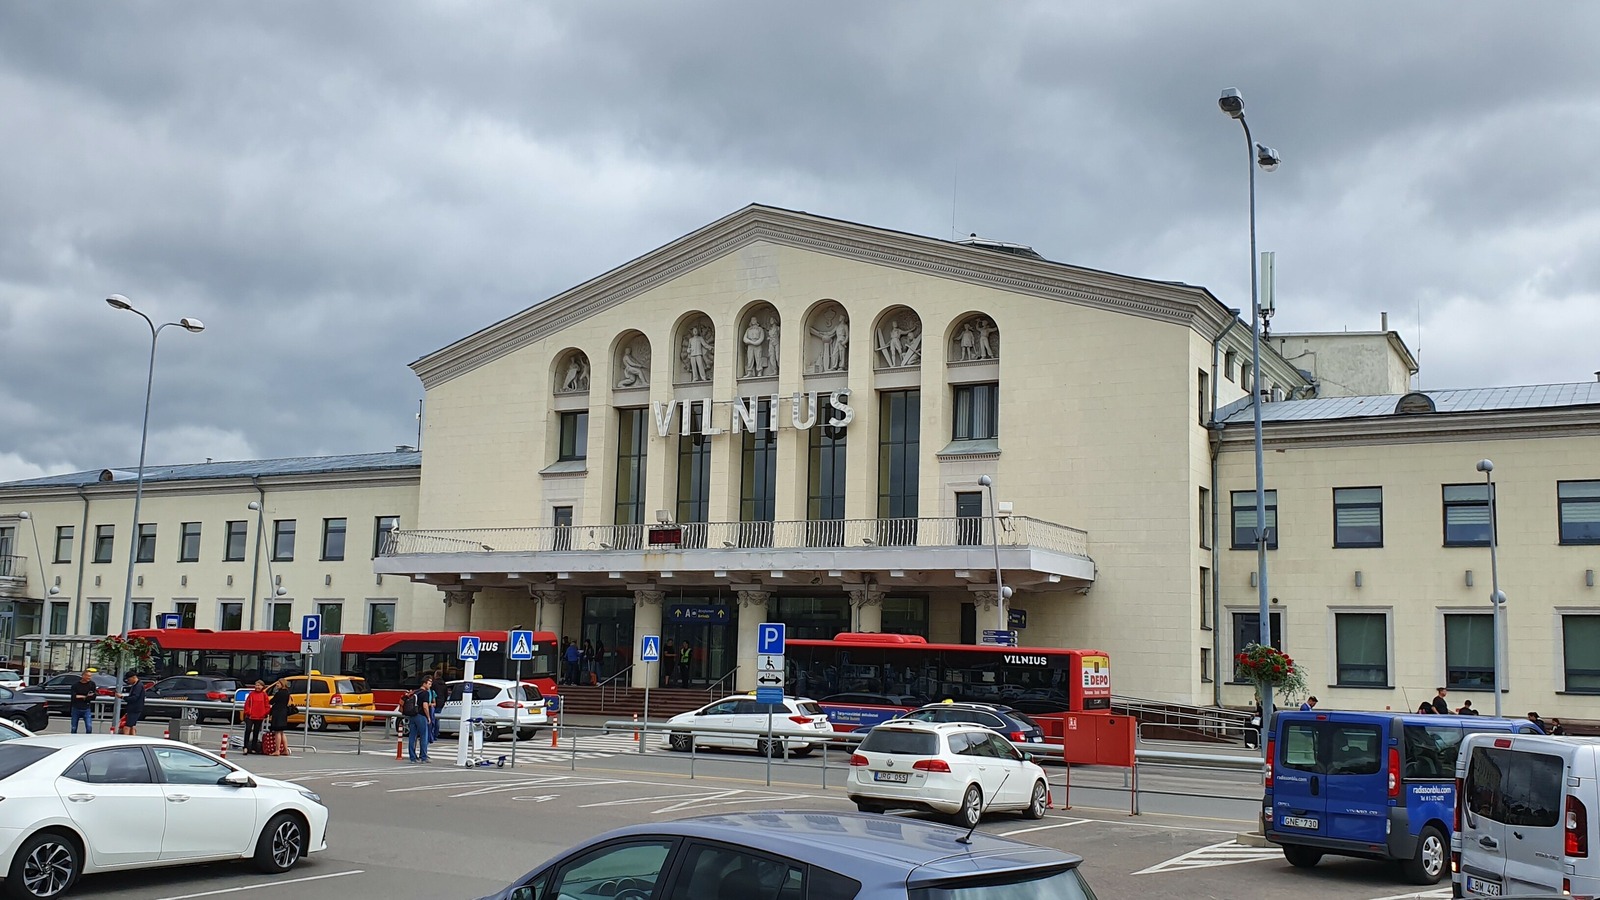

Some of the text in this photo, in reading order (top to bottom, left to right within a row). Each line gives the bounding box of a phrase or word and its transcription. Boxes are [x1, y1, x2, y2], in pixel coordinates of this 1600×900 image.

[653, 387, 855, 437] VILNIUS
[306, 617, 317, 638] P
[764, 627, 779, 650] P
[1003, 654, 1047, 666] VILNIUS
[1090, 674, 1108, 685] DEPO
[1285, 816, 1317, 828] GNE 730
[1471, 880, 1499, 896] LBM 423
